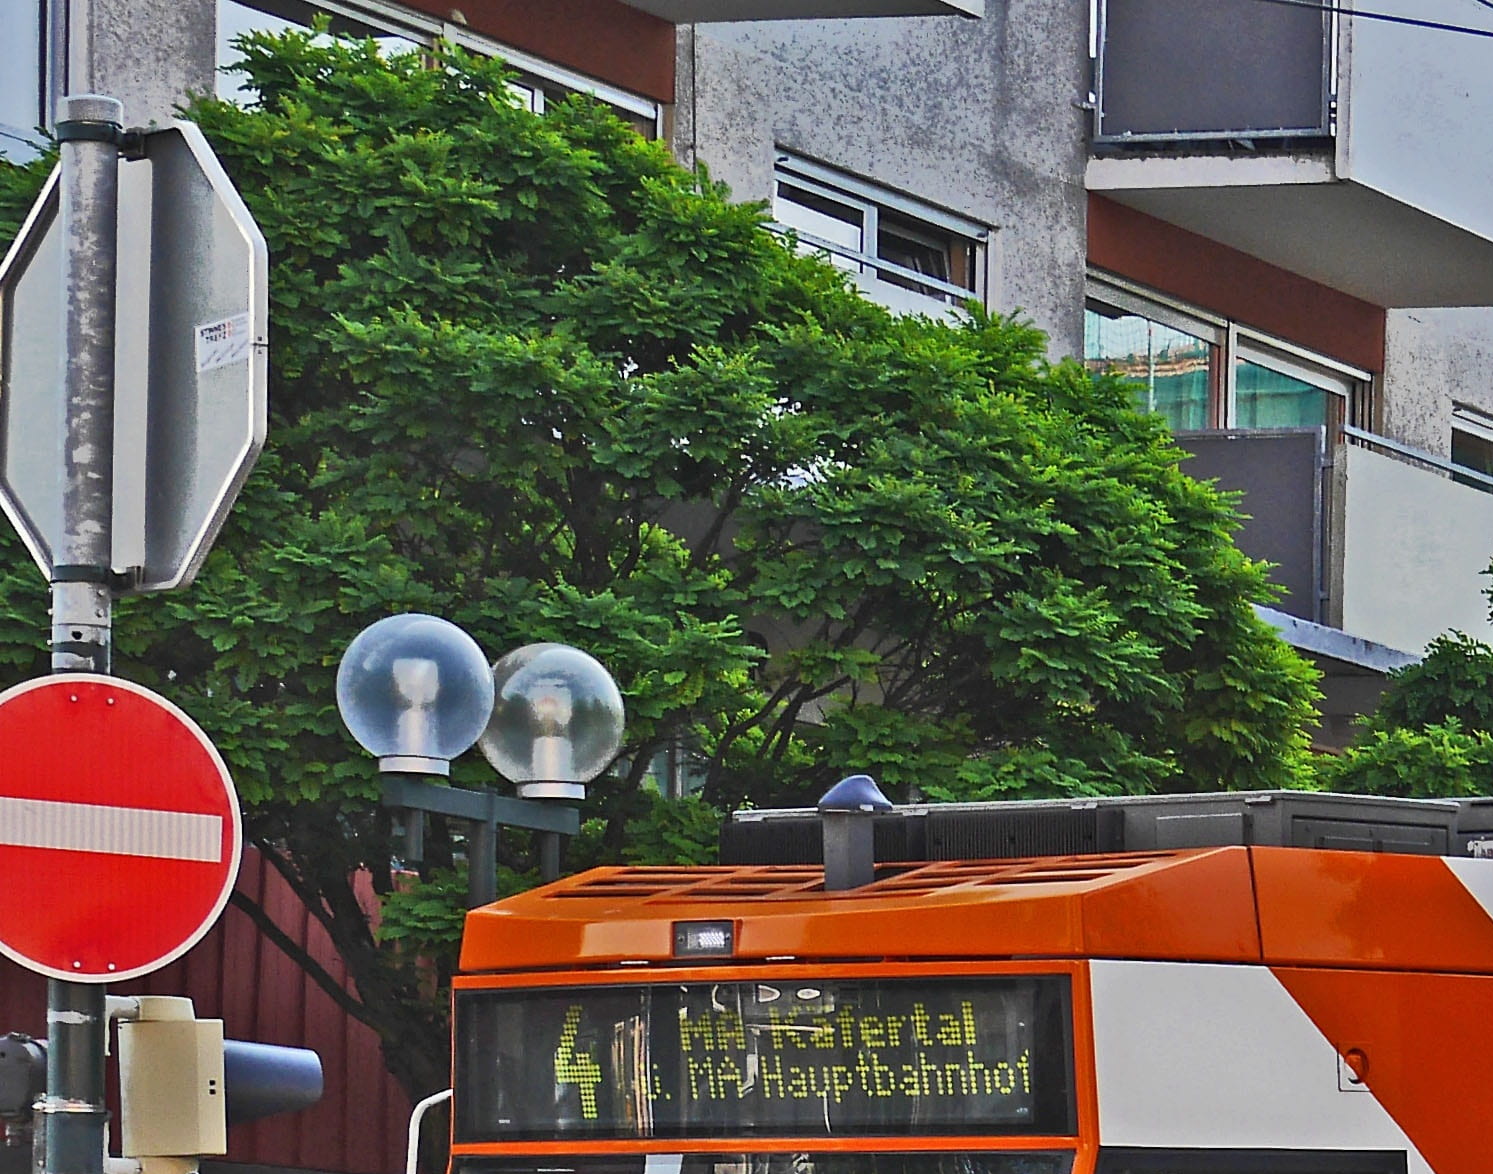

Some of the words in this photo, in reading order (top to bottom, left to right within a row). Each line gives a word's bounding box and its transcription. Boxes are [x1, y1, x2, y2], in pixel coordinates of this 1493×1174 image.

[679, 1008, 747, 1051] MA
[554, 1005, 601, 1120] 4
[760, 1048, 1030, 1104] Hauptbahnhof
